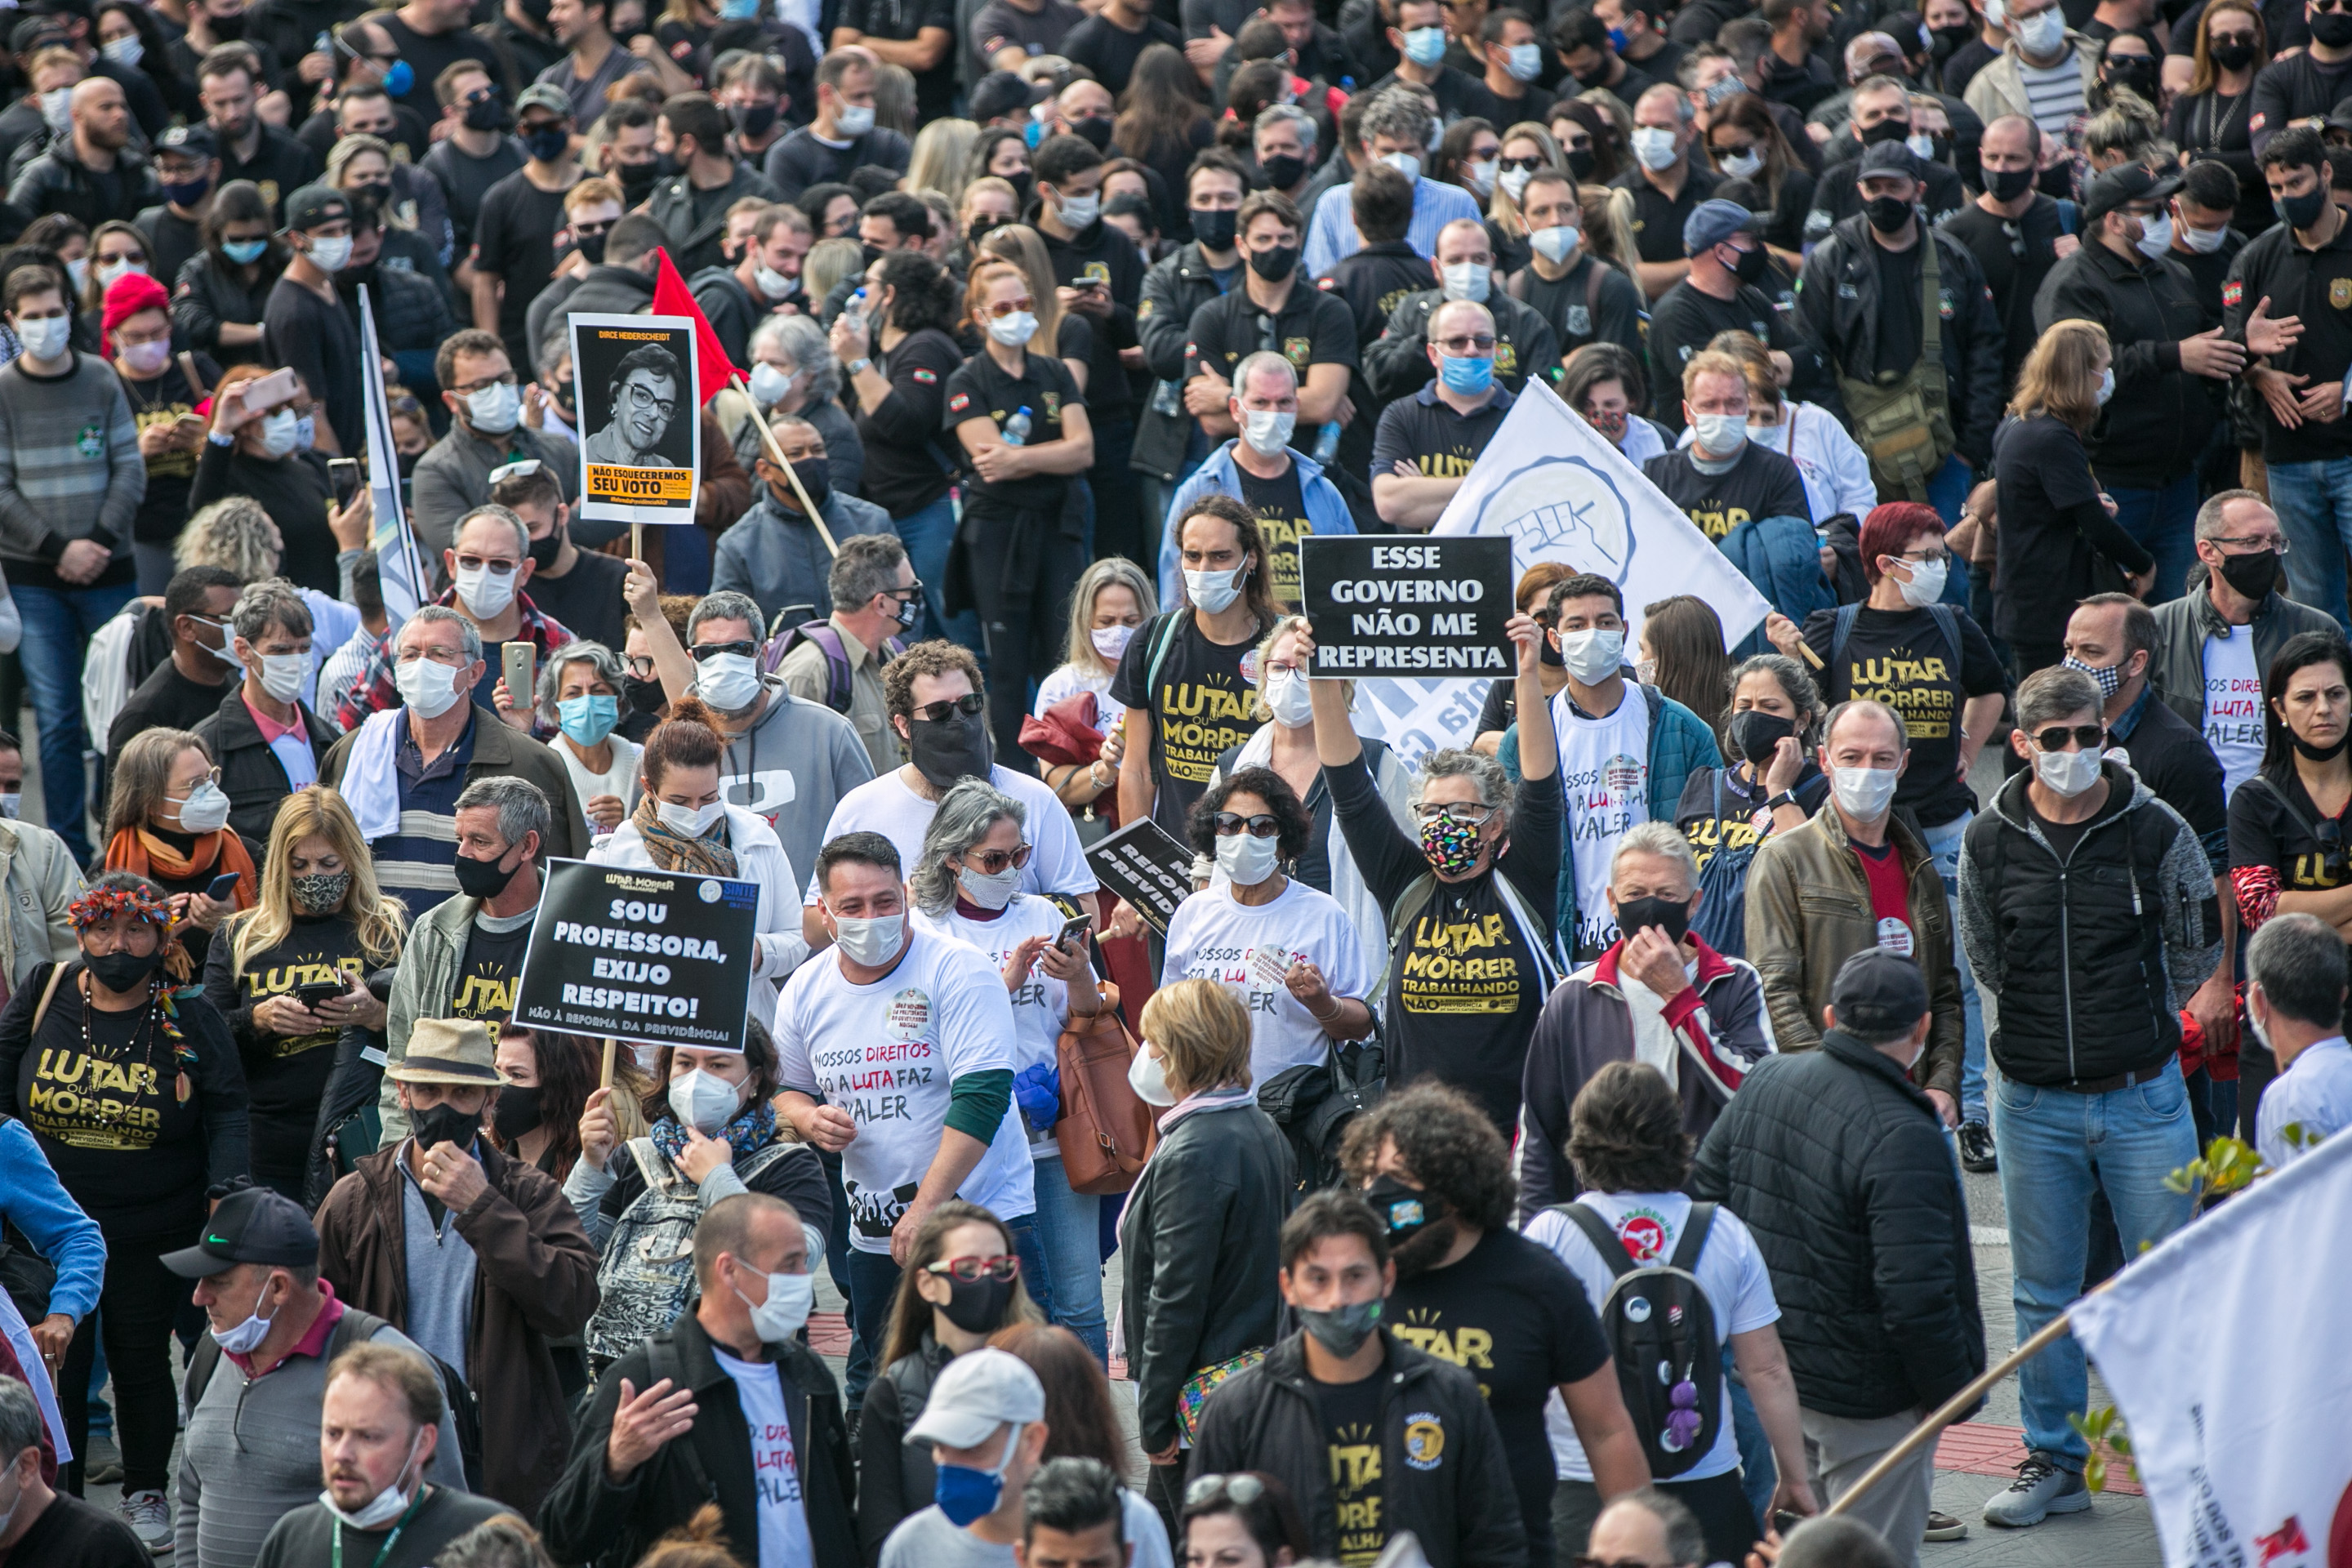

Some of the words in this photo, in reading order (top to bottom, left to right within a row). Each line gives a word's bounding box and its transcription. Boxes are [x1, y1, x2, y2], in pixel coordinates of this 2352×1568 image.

[599, 330, 618, 340] DIRCE
[593, 466, 611, 476] NÃO
[614, 469, 687, 480] ESQUECEREMOS
[594, 477, 618, 492] SEU
[621, 479, 662, 495] VOTO
[1372, 546, 1441, 569] ESSE
[1330, 579, 1484, 603] GOVERNO
[1352, 608, 1421, 635] NÃO
[1431, 613, 1477, 635] ME
[1318, 645, 1508, 668] REPRESENTA
[1851, 657, 1951, 685] LUTAR
[1192, 715, 1209, 726] OU
[2212, 700, 2254, 718] LUTA
[1163, 717, 1253, 750] MORRE
[2206, 722, 2264, 746] ALER
[1166, 762, 1192, 777] NÃO
[1575, 812, 1631, 841] VALER
[636, 877, 675, 891] MORRER
[1098, 849, 1175, 915] PREVID
[1120, 843, 1190, 902] REFOR
[723, 882, 756, 898] SINTE
[608, 898, 668, 924] SOU
[554, 921, 728, 964] PROFESSORA,
[1414, 913, 1511, 956] LUTAR
[1195, 948, 1242, 961] OSSOS
[1439, 947, 1455, 956] OU
[592, 956, 671, 986] EXIJO
[1212, 968, 1221, 981] A
[1403, 951, 1519, 980] MORRER
[1402, 978, 1520, 994] TRABALHANDO
[562, 982, 699, 1019] RESPEITO!
[1404, 996, 1440, 1011] NÃO
[458, 1009, 477, 1019] OU
[528, 1007, 551, 1020] NÃO
[554, 1008, 563, 1021] À
[566, 1013, 618, 1029] REFORMA
[621, 1020, 640, 1032] DA
[644, 1022, 729, 1041] PREVIDÊNCIA!
[815, 1049, 862, 1068] NOSSOS
[866, 1043, 931, 1062] DIREITOS
[36, 1048, 159, 1095] LUTAR
[819, 1071, 834, 1093] SÓ
[840, 1075, 850, 1094] A
[852, 1070, 894, 1090] LUTA
[897, 1067, 933, 1088] FAZ
[67, 1084, 87, 1094] OU
[29, 1082, 161, 1129] MORRER
[30, 1111, 158, 1140] TRABALHANDO
[70, 1136, 114, 1144] PREVIDÊNCIA
